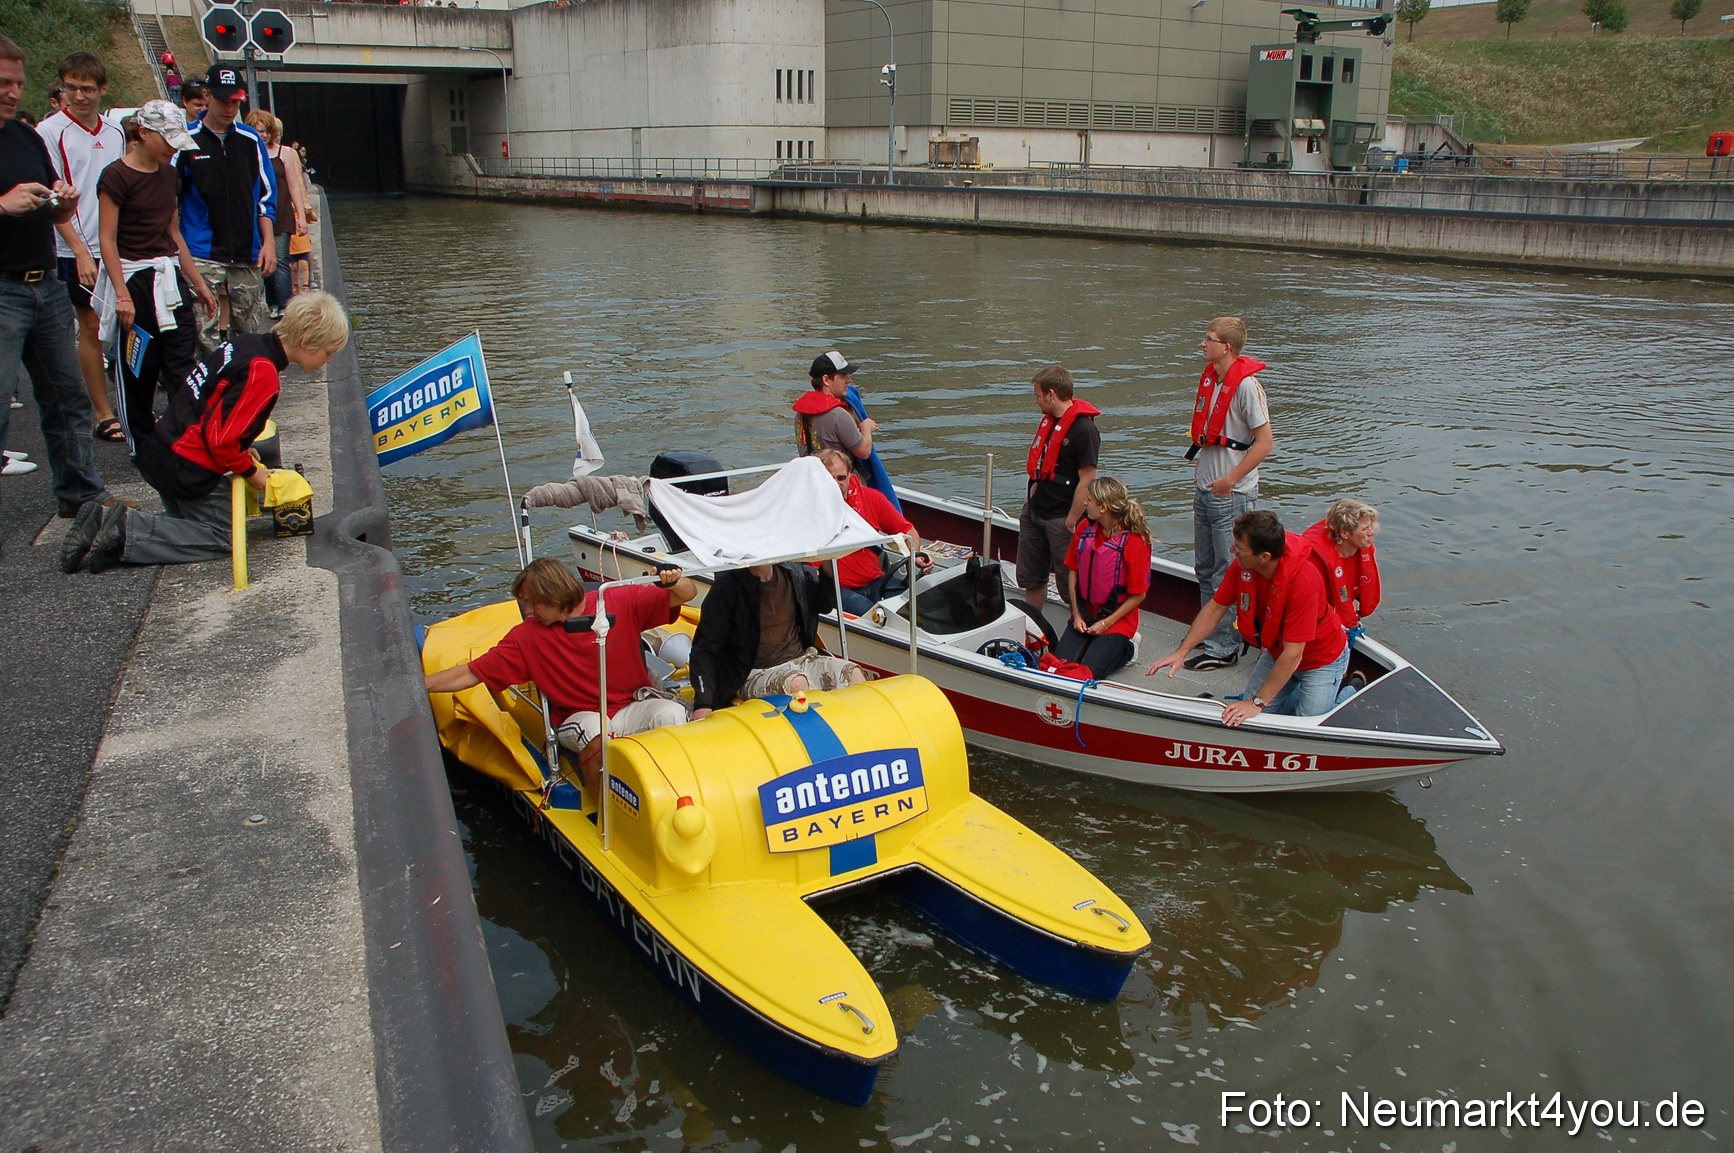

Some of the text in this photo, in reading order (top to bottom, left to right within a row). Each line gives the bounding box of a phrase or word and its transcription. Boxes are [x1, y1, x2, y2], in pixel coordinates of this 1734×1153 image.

[1266, 50, 1287, 60] MUHR
[377, 366, 463, 427] antenne
[377, 397, 467, 447] BAYERN
[1165, 742, 1319, 771] JURA 161
[610, 778, 638, 807] antenne
[775, 758, 909, 814] antenne
[782, 796, 914, 843] BAYERN
